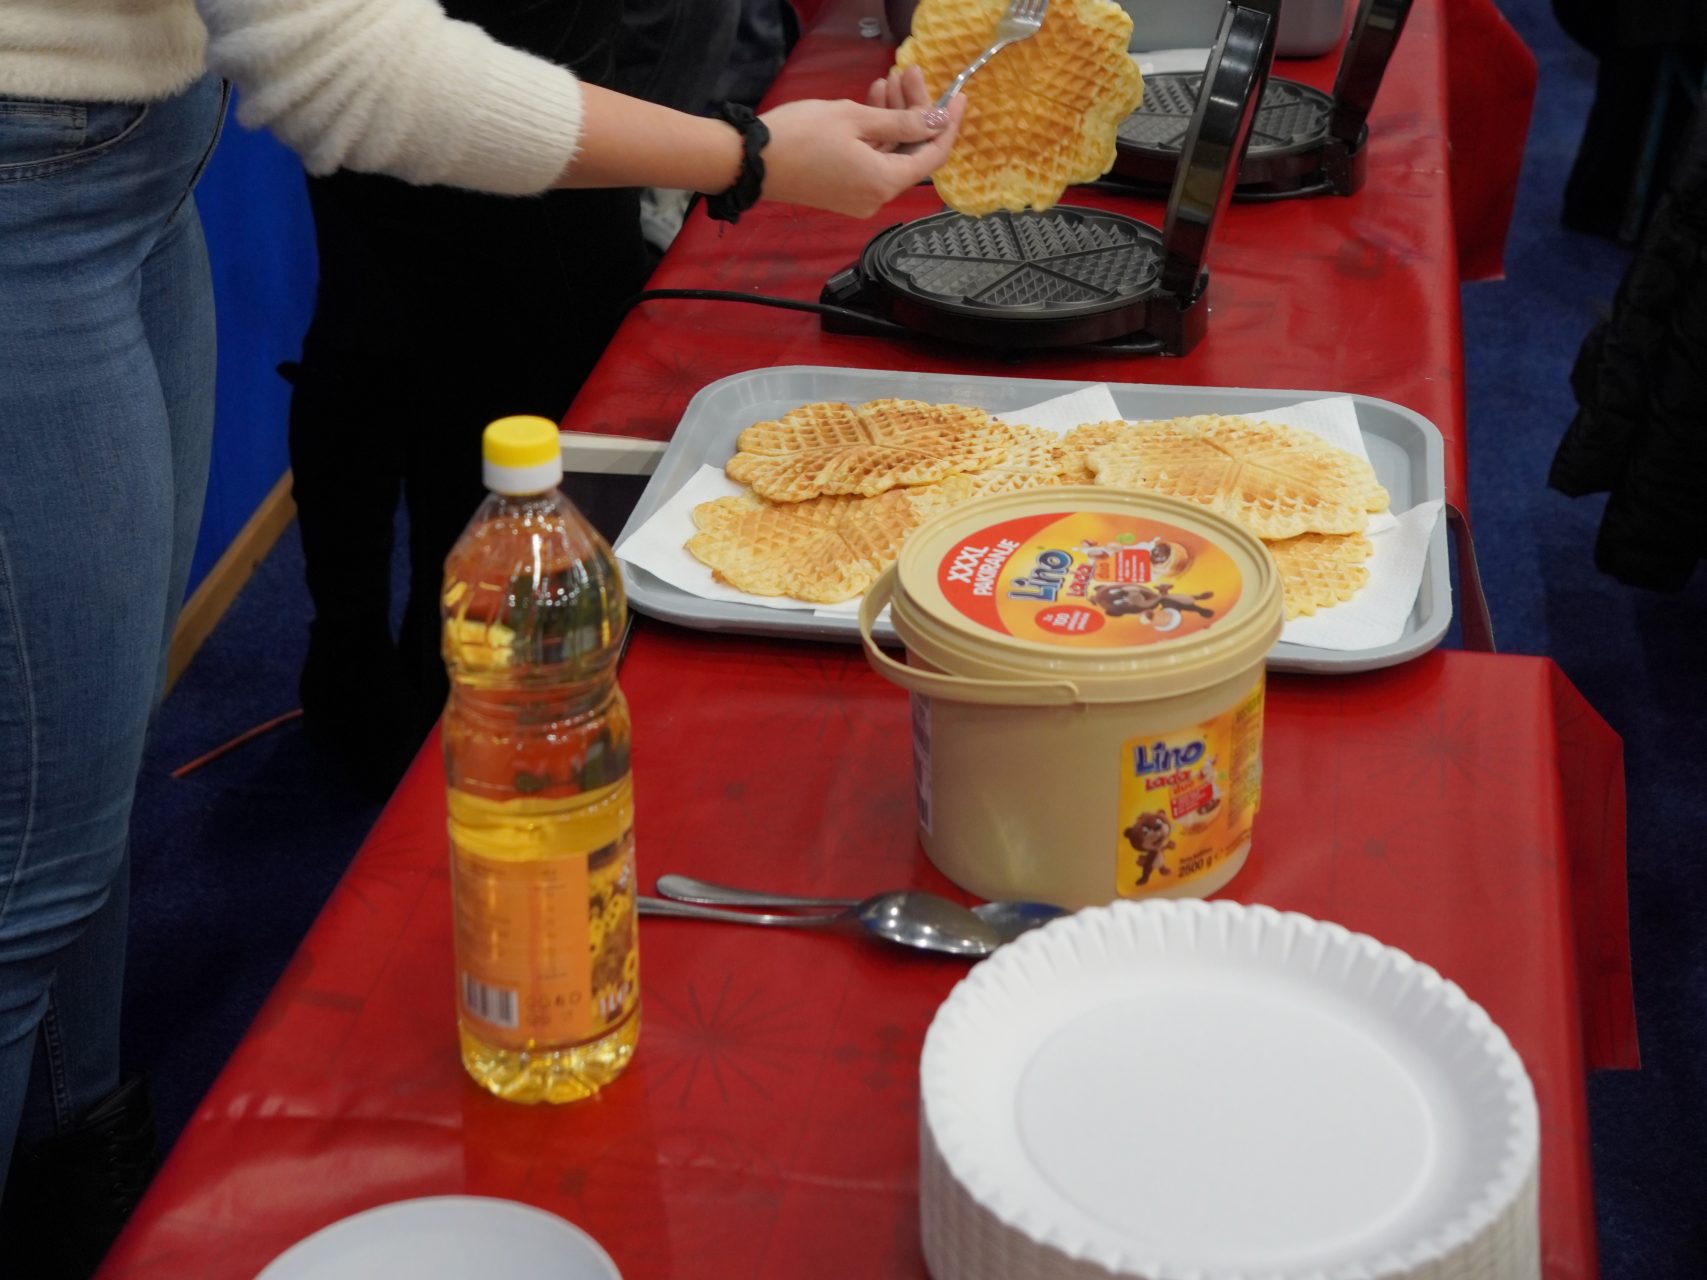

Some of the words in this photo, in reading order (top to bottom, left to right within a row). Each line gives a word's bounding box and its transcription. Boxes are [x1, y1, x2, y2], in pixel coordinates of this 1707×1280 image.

[947, 546, 990, 584] XXXL
[1007, 549, 1074, 602] Lino
[1134, 741, 1206, 776] Lino
